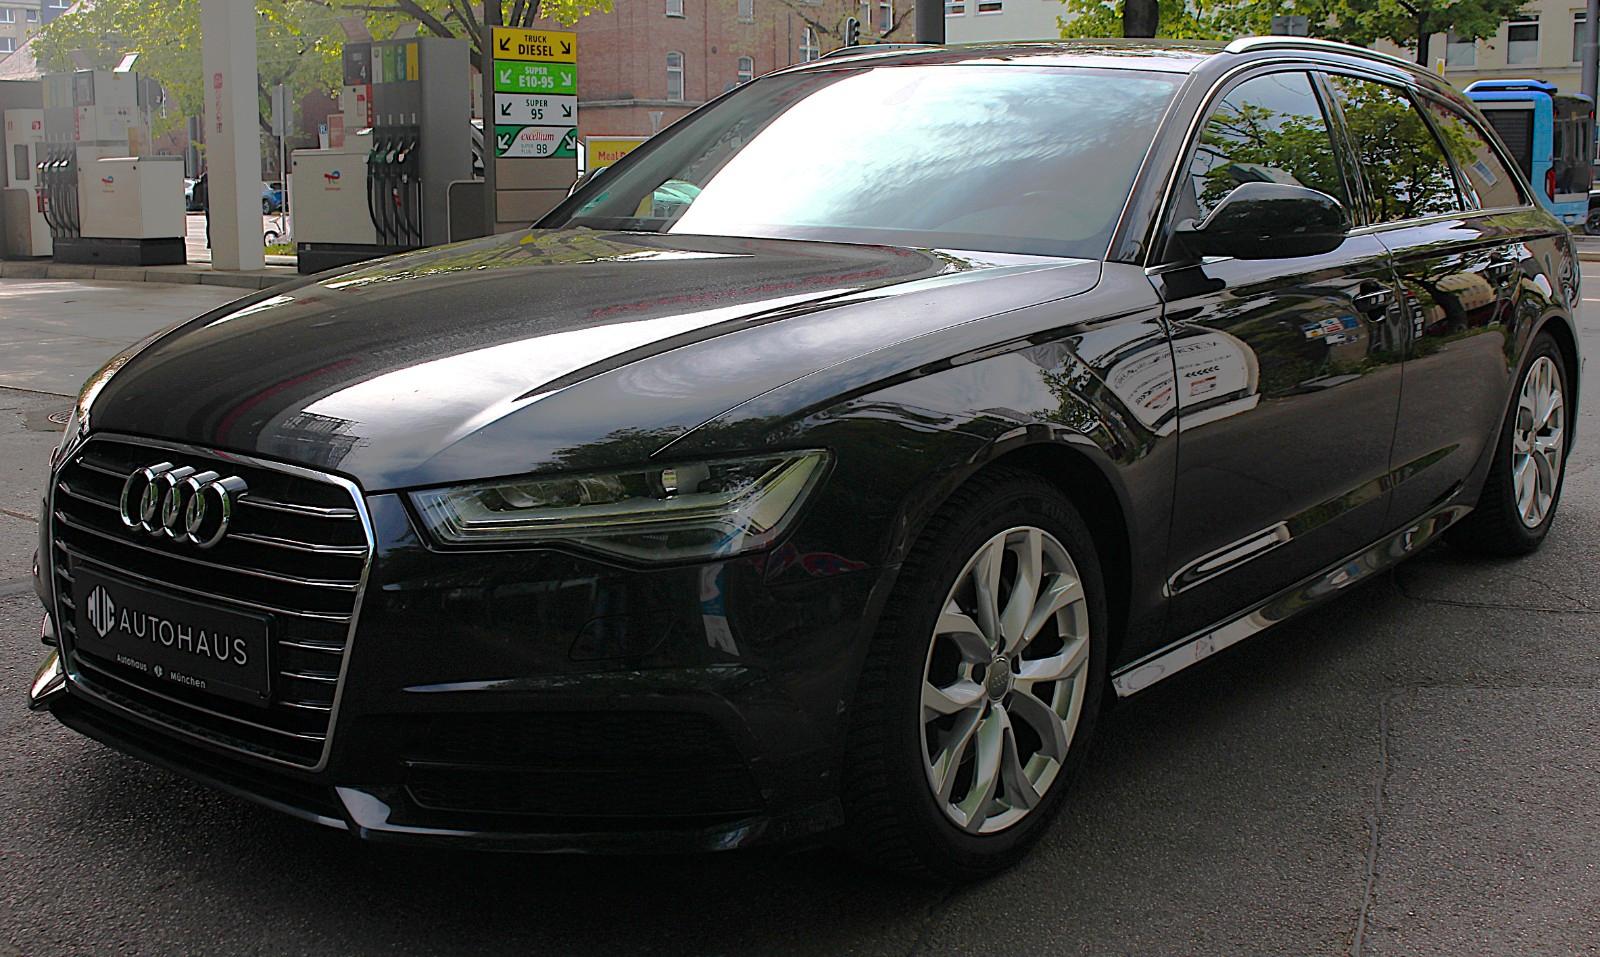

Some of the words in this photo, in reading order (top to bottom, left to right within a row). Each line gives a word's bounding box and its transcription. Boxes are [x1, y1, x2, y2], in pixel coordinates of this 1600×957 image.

[524, 34, 547, 43] TRUCK
[518, 43, 554, 57] DIESEL
[524, 66, 548, 75] SUPER
[526, 98, 548, 107] SUPER
[531, 108, 544, 120] 95
[520, 131, 554, 142] excellium
[536, 143, 548, 154] 98
[598, 151, 619, 161] Meal
[119, 608, 248, 665] AUTOHAUS
[116, 653, 148, 672] Autohaus
[170, 671, 206, 689] München
